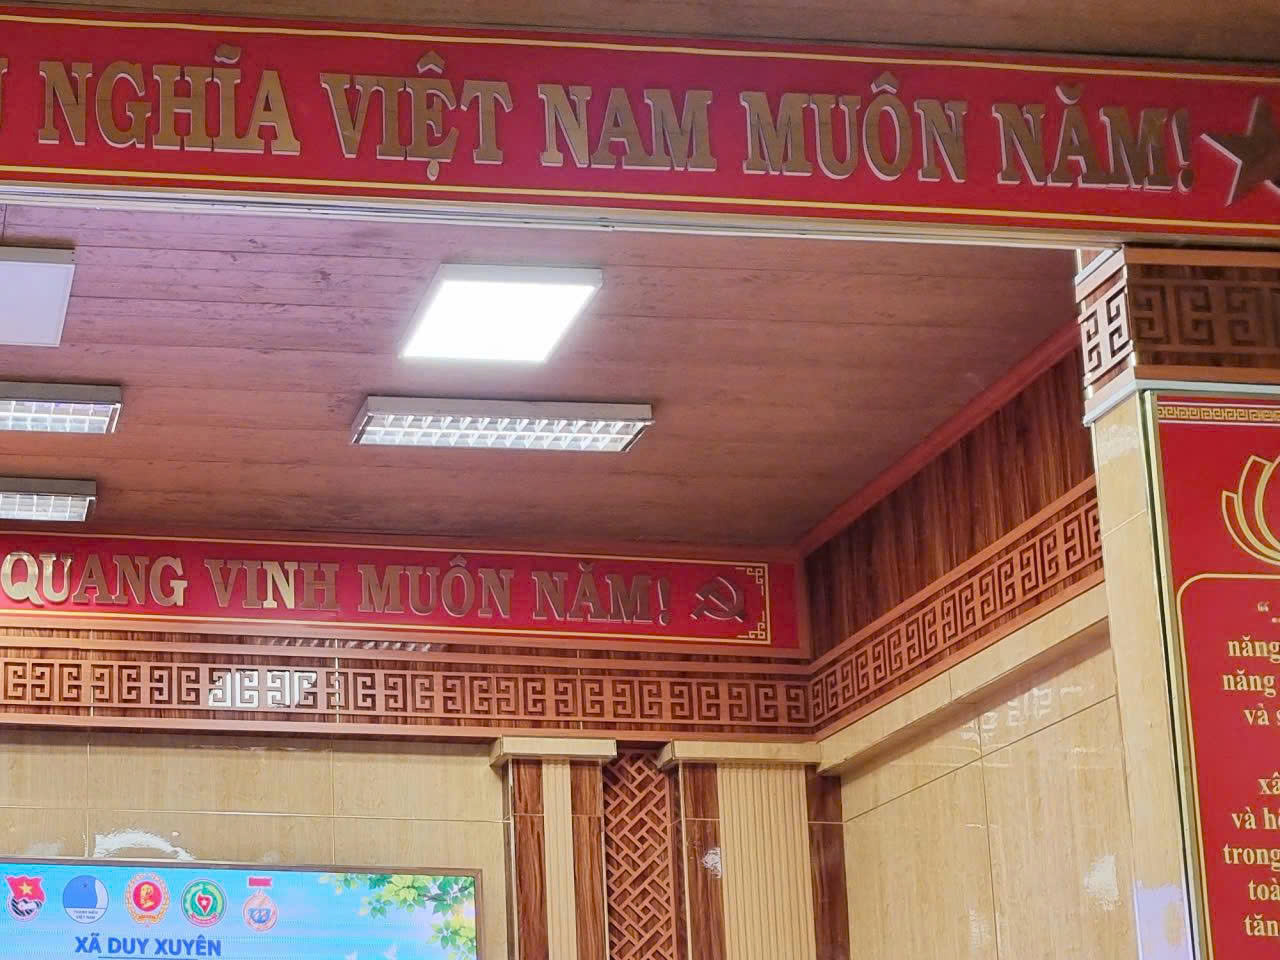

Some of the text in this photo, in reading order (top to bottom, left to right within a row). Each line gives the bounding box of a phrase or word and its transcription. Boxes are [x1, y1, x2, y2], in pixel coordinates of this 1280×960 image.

[38, 44, 301, 156] NGHĨA
[320, 50, 513, 181] VIỆT
[537, 83, 718, 172] NAM
[739, 70, 968, 183] MUÔN
[991, 84, 1196, 193] NĂM!
[0, 550, 188, 608] QUANG
[203, 558, 341, 613] VINH
[357, 554, 515, 619] MUÔN
[531, 562, 671, 626] NĂM!
[1222, 668, 1277, 698] năng
[1232, 806, 1257, 830] và
[74, 932, 222, 957] XÃ DUY XUYÊN
